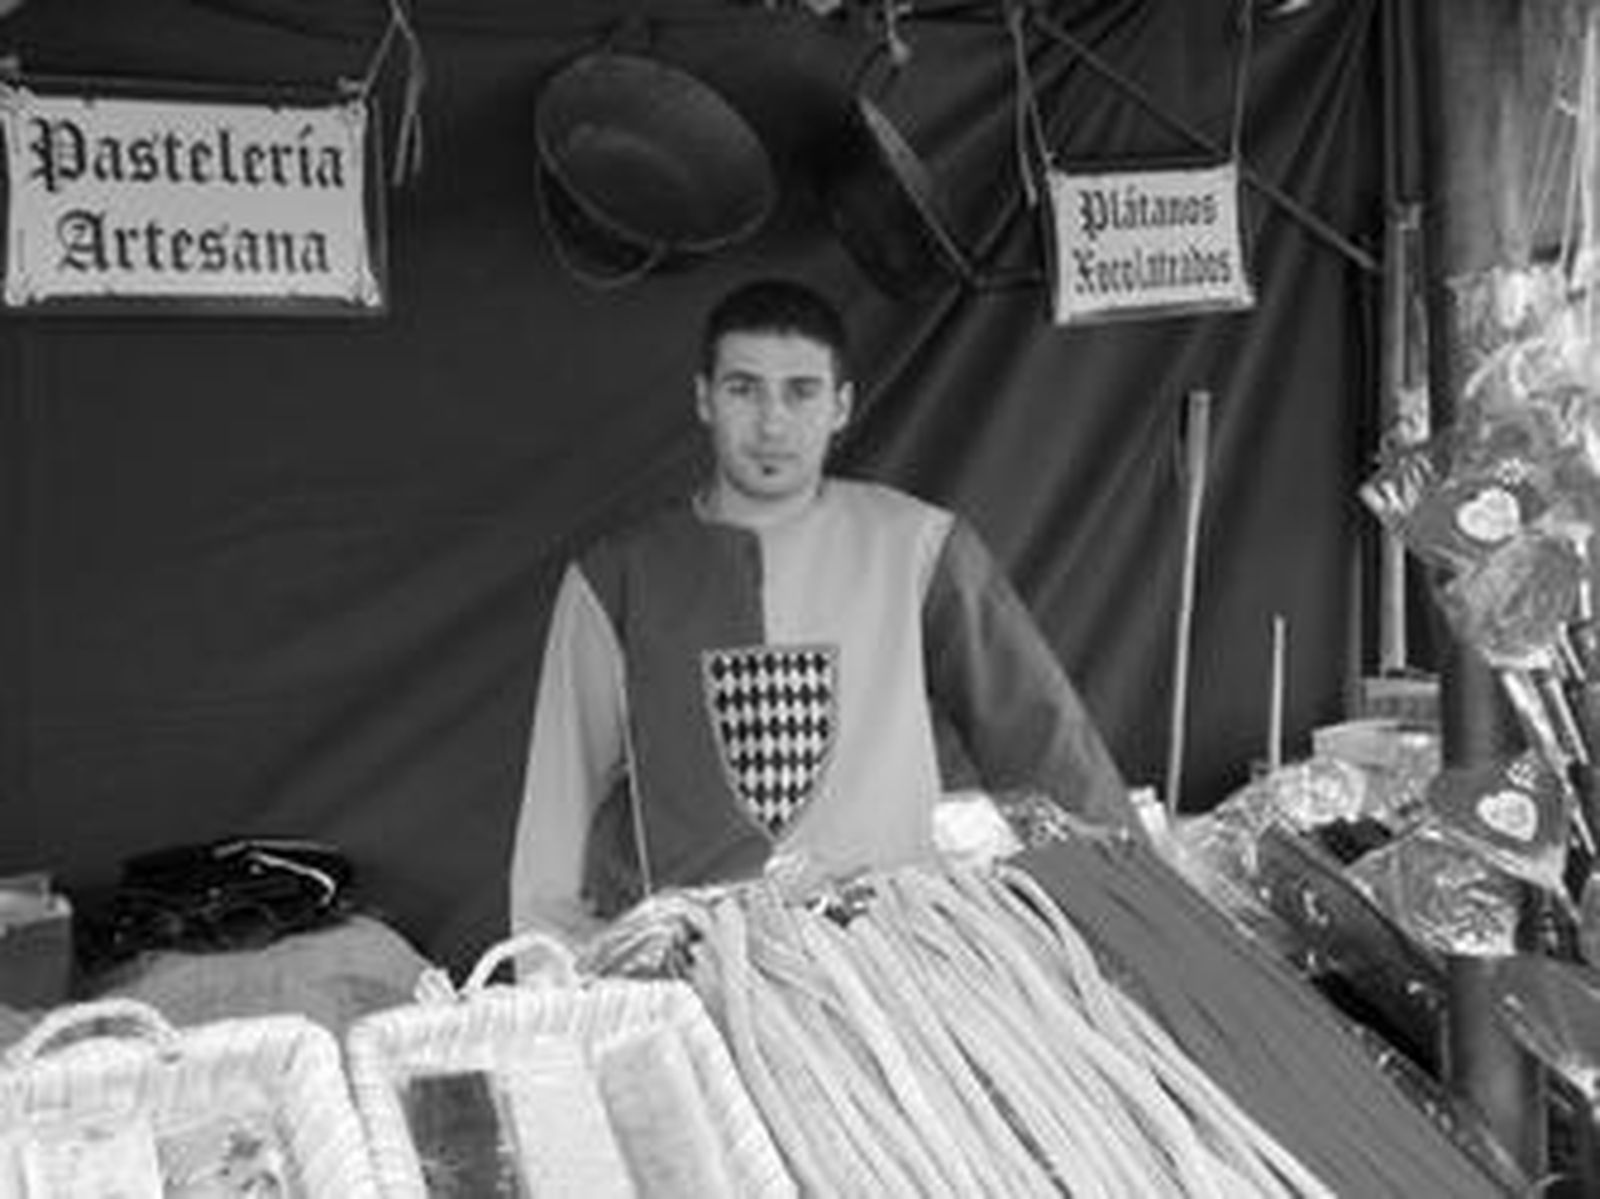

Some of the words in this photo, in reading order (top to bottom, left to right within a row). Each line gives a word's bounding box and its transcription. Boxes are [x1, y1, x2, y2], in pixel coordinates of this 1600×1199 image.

[30, 116, 344, 192] Pastelería
[56, 208, 330, 273] Artesana
[1077, 183, 1219, 241] Plátanos
